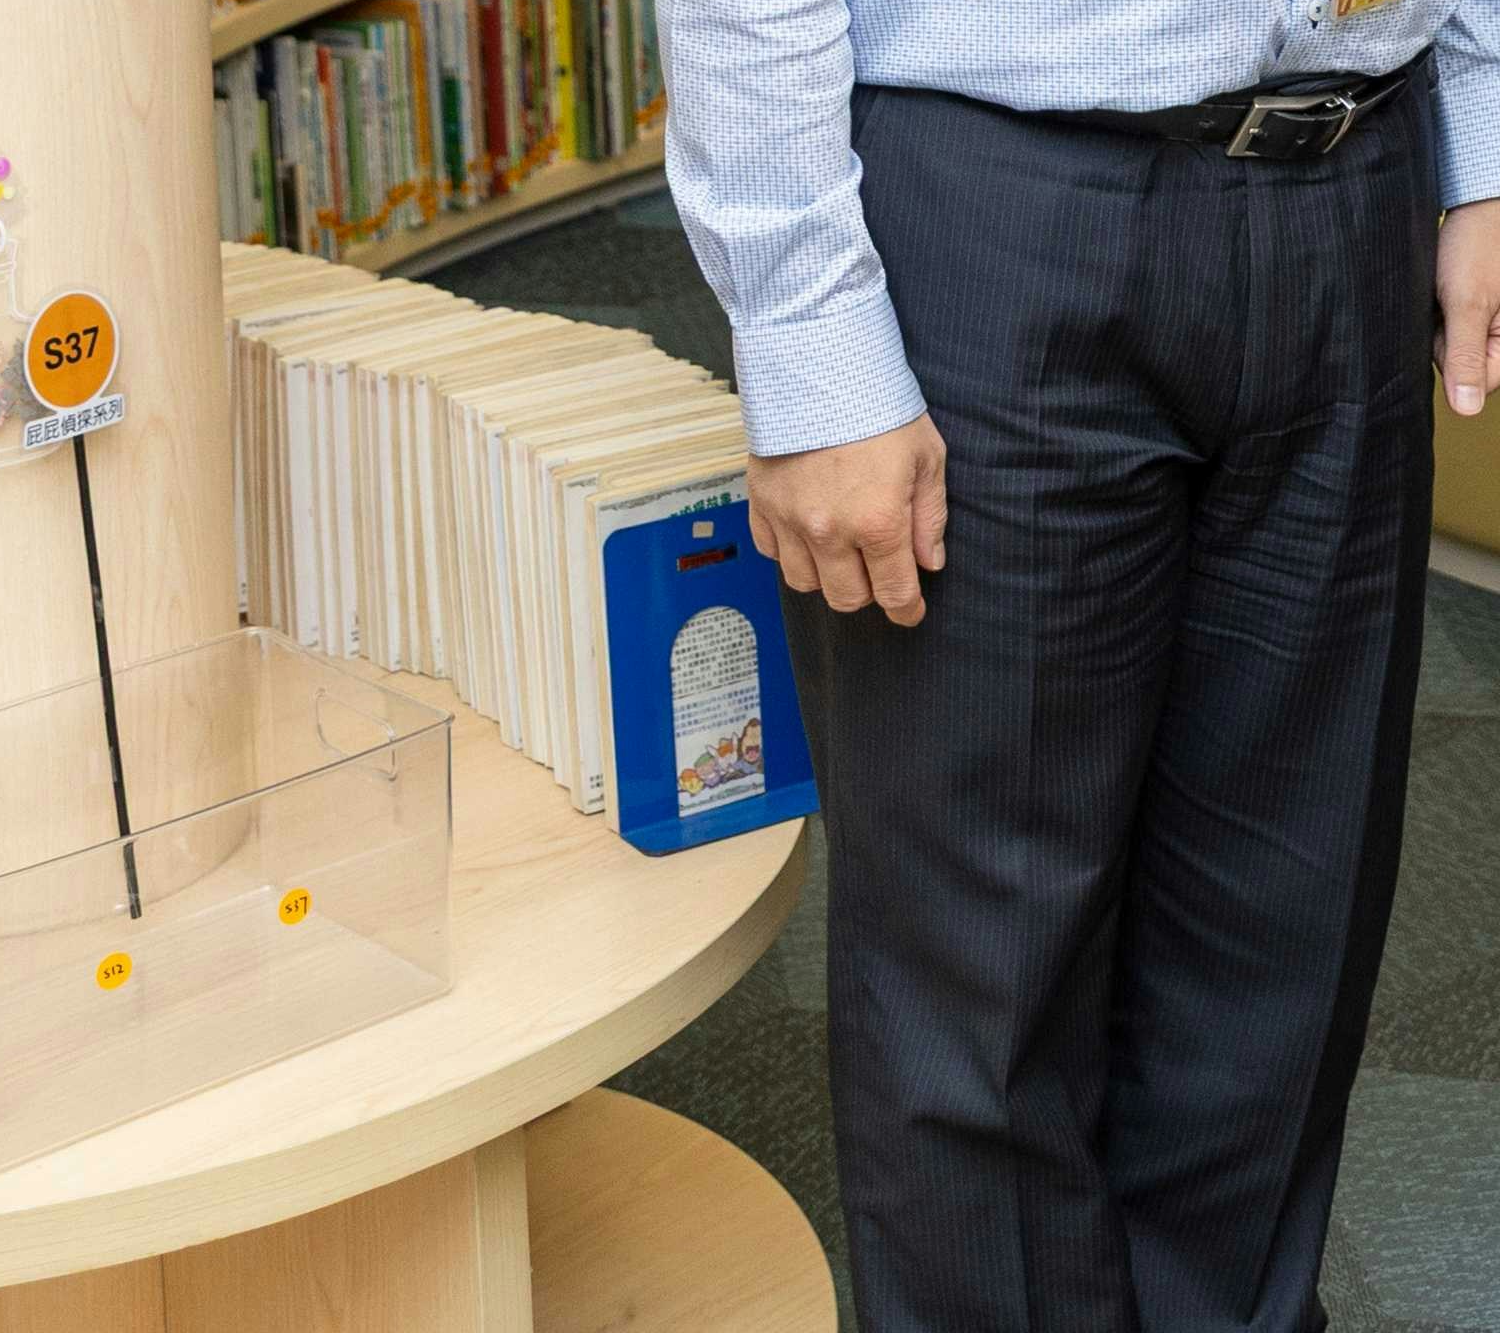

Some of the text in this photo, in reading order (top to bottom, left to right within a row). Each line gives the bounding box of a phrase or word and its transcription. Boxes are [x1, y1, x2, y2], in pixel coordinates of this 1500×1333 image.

[42, 325, 101, 372] S37
[25, 398, 123, 448] 屁屁偵探系列
[284, 896, 308, 916] S37
[103, 964, 125, 981] S12
